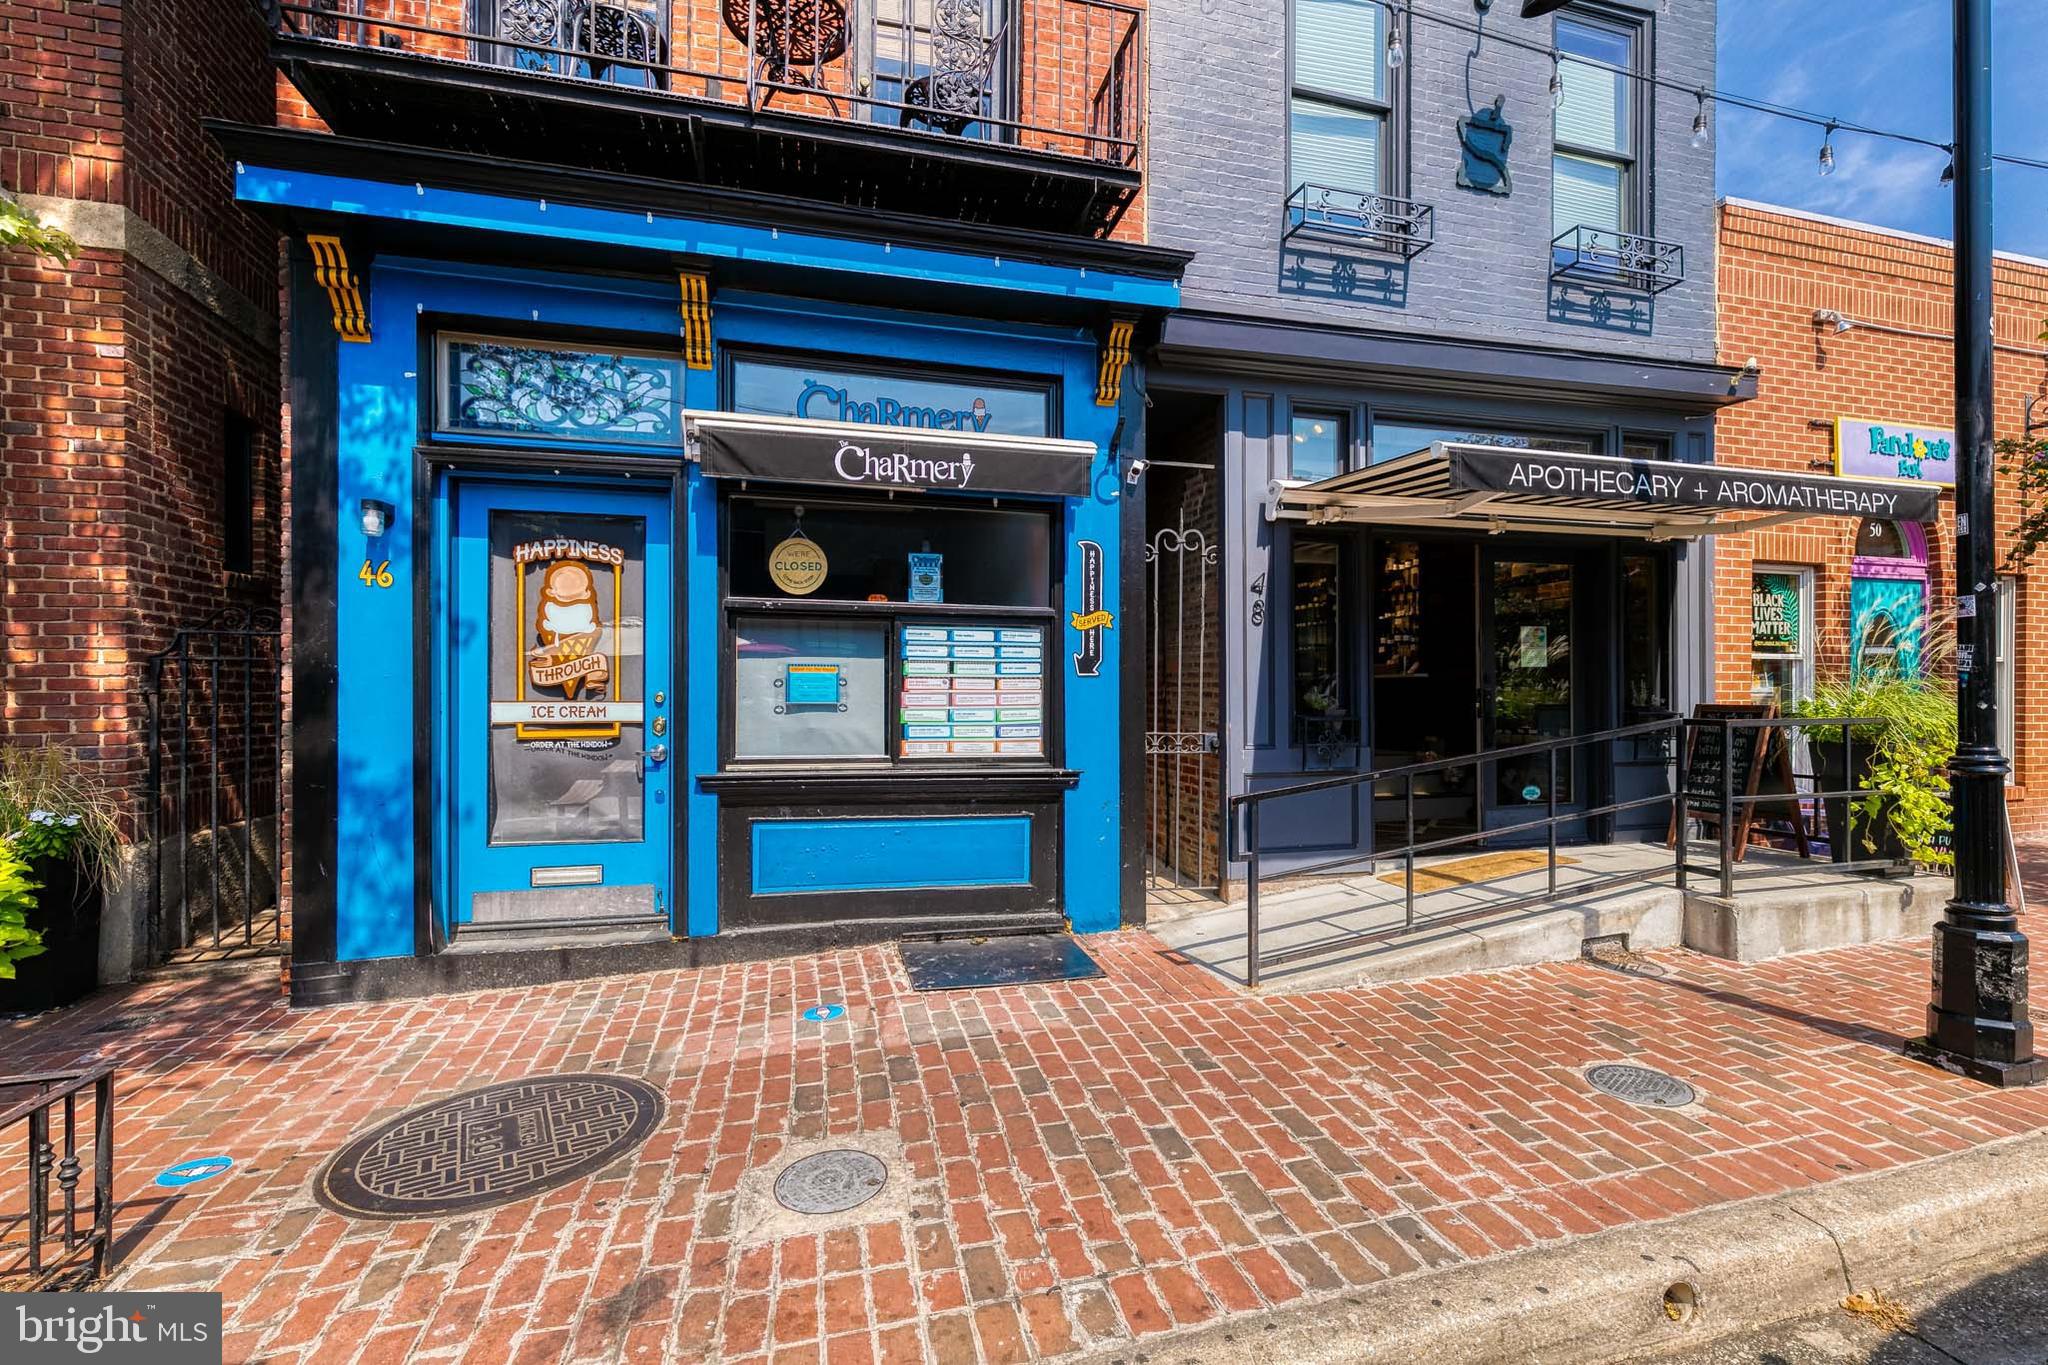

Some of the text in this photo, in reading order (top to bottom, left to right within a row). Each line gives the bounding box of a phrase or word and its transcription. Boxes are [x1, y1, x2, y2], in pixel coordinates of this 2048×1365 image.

[1509, 462, 1684, 499] APOTHECARY
[1717, 480, 1898, 515] AROMATHERAPY
[1869, 522, 1882, 538] 50
[515, 539, 623, 565] HAPPINESS
[775, 561, 822, 571] CLOSED
[359, 559, 394, 588] 46
[1753, 593, 1784, 607] BLACK
[1078, 613, 1106, 627] SERVED
[1754, 607, 1783, 621] LIVES
[1752, 621, 1791, 635] MATTER
[535, 656, 601, 683] THROUGH
[531, 705, 607, 718] ICE CREAM
[530, 741, 554, 749] ORDER
